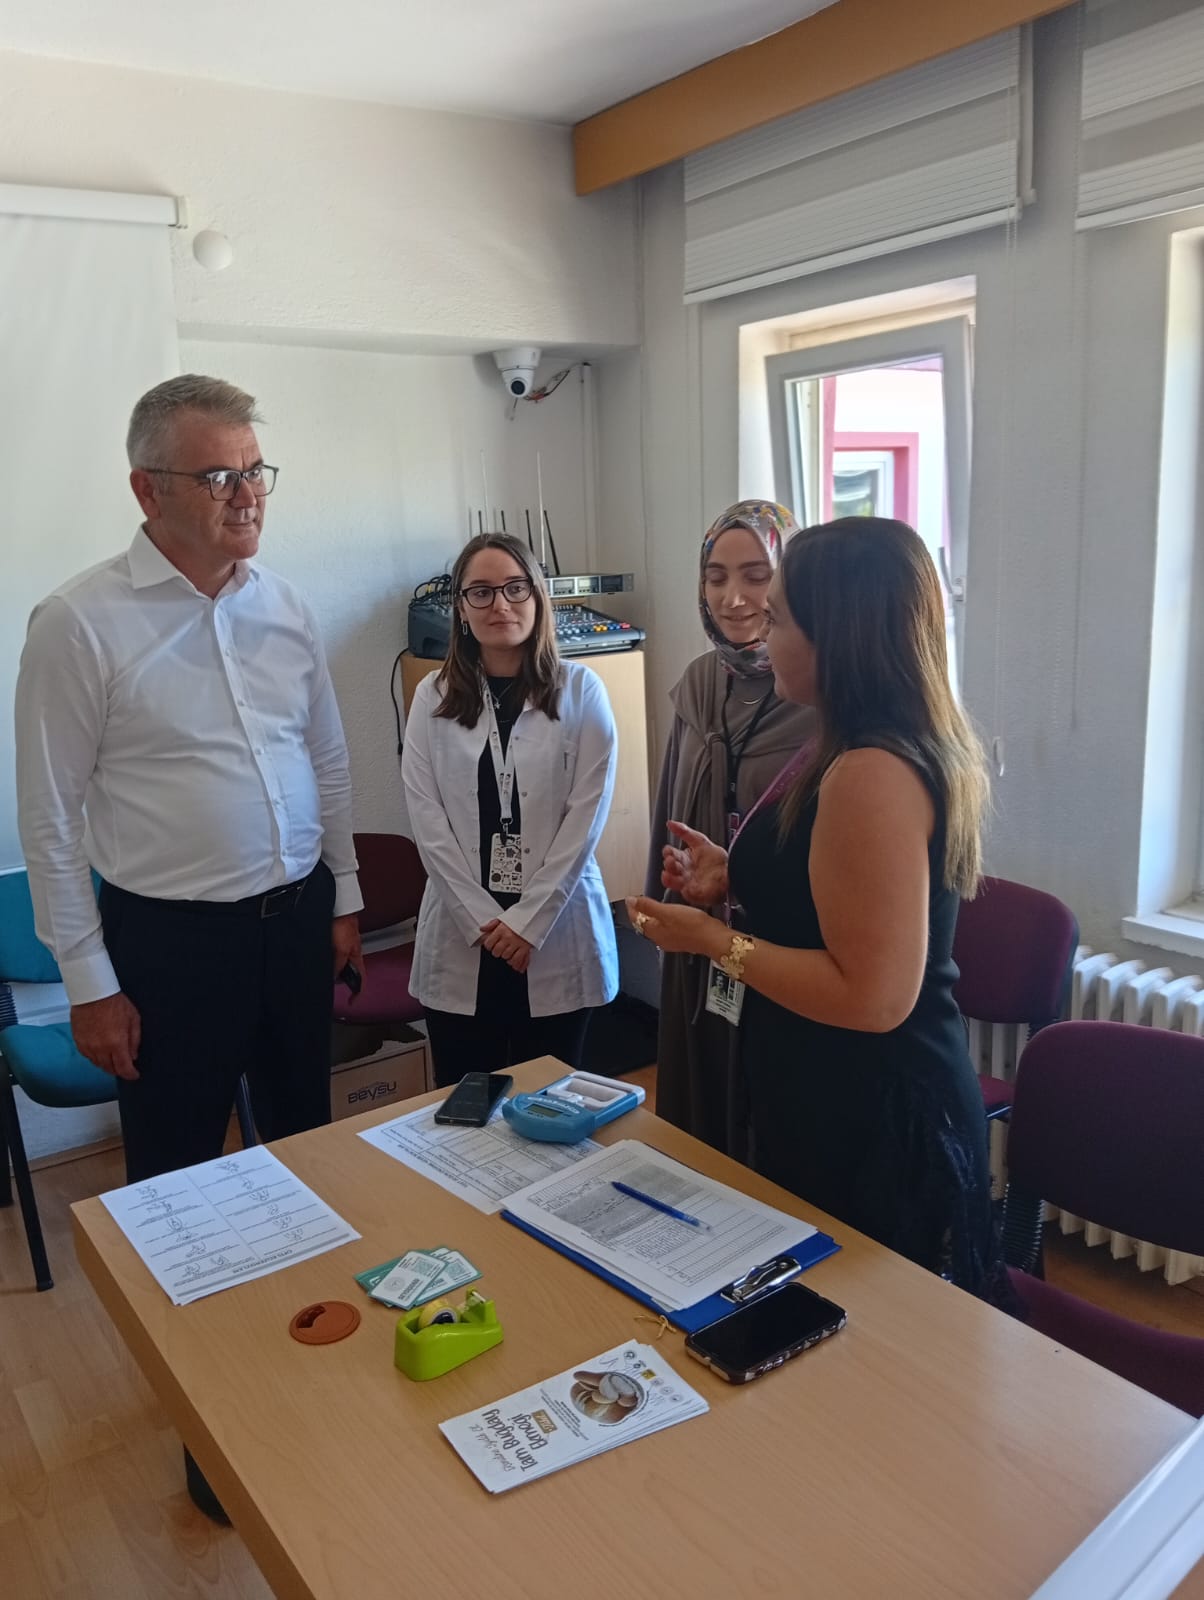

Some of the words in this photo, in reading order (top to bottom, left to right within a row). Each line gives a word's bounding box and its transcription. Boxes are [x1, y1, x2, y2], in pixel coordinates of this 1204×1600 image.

[482, 1409, 520, 1450] Buğday
[507, 1413, 548, 1450] Ekmeği
[515, 1447, 538, 1472] Tam
